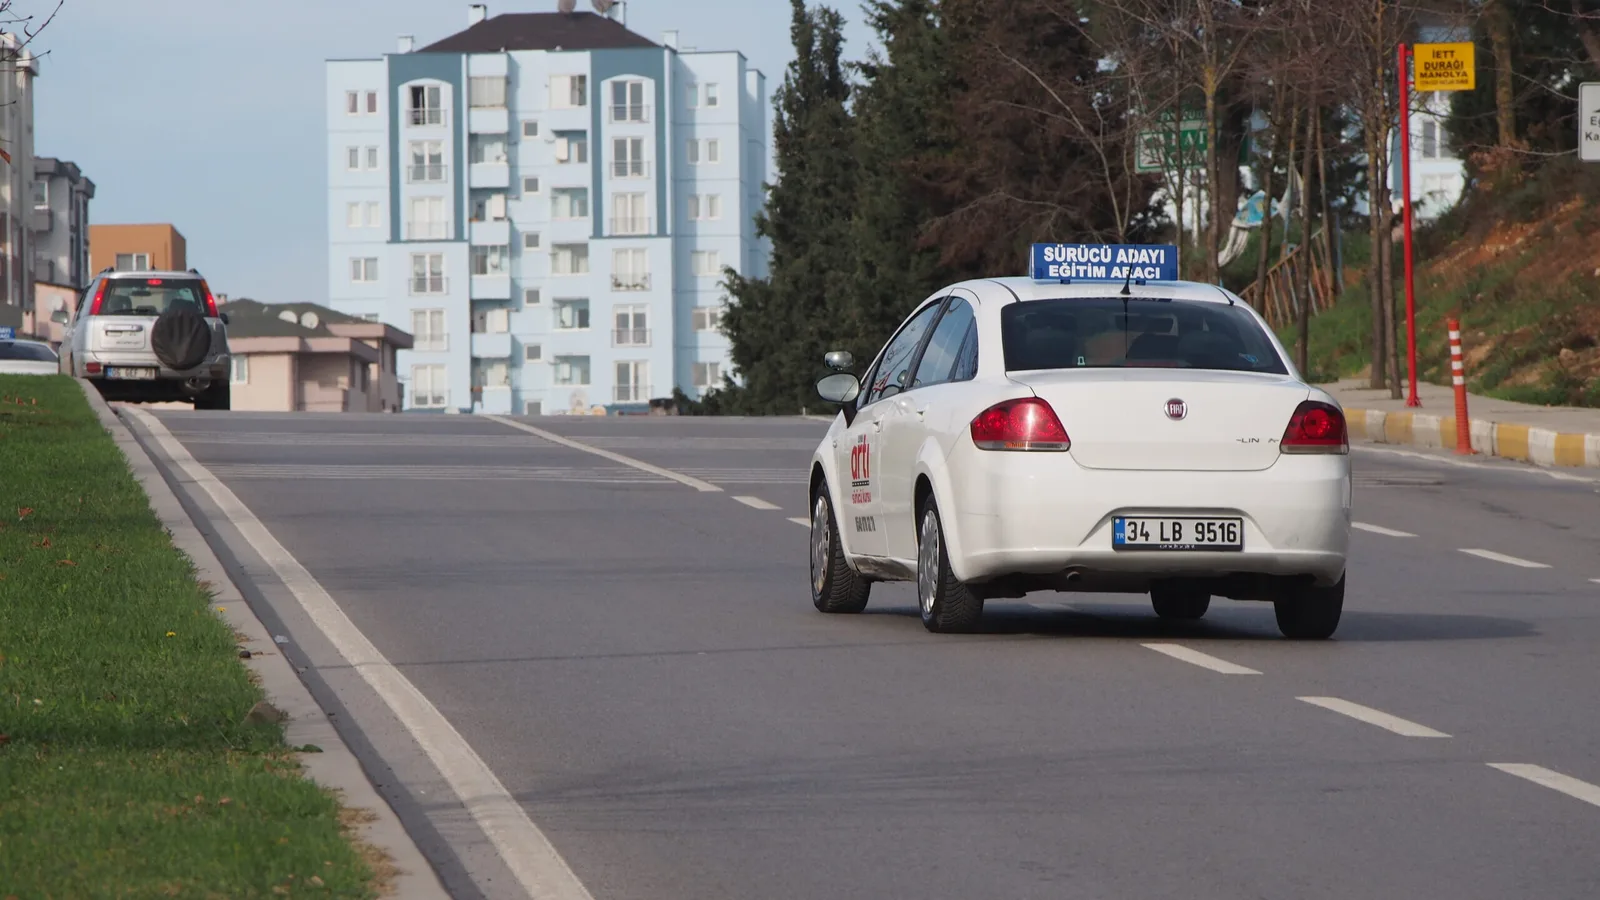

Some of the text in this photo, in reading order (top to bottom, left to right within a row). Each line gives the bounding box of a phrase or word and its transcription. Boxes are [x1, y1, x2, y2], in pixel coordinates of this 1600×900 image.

[1424, 59, 1464, 70] DURAĞI
[1044, 244, 1165, 264] SÜRÜCÜ ADAYI
[1048, 262, 1160, 279] EĞİTİM ARACI
[1170, 403, 1183, 415] FIAT
[1116, 521, 1237, 543] TR 34 LB 9516
